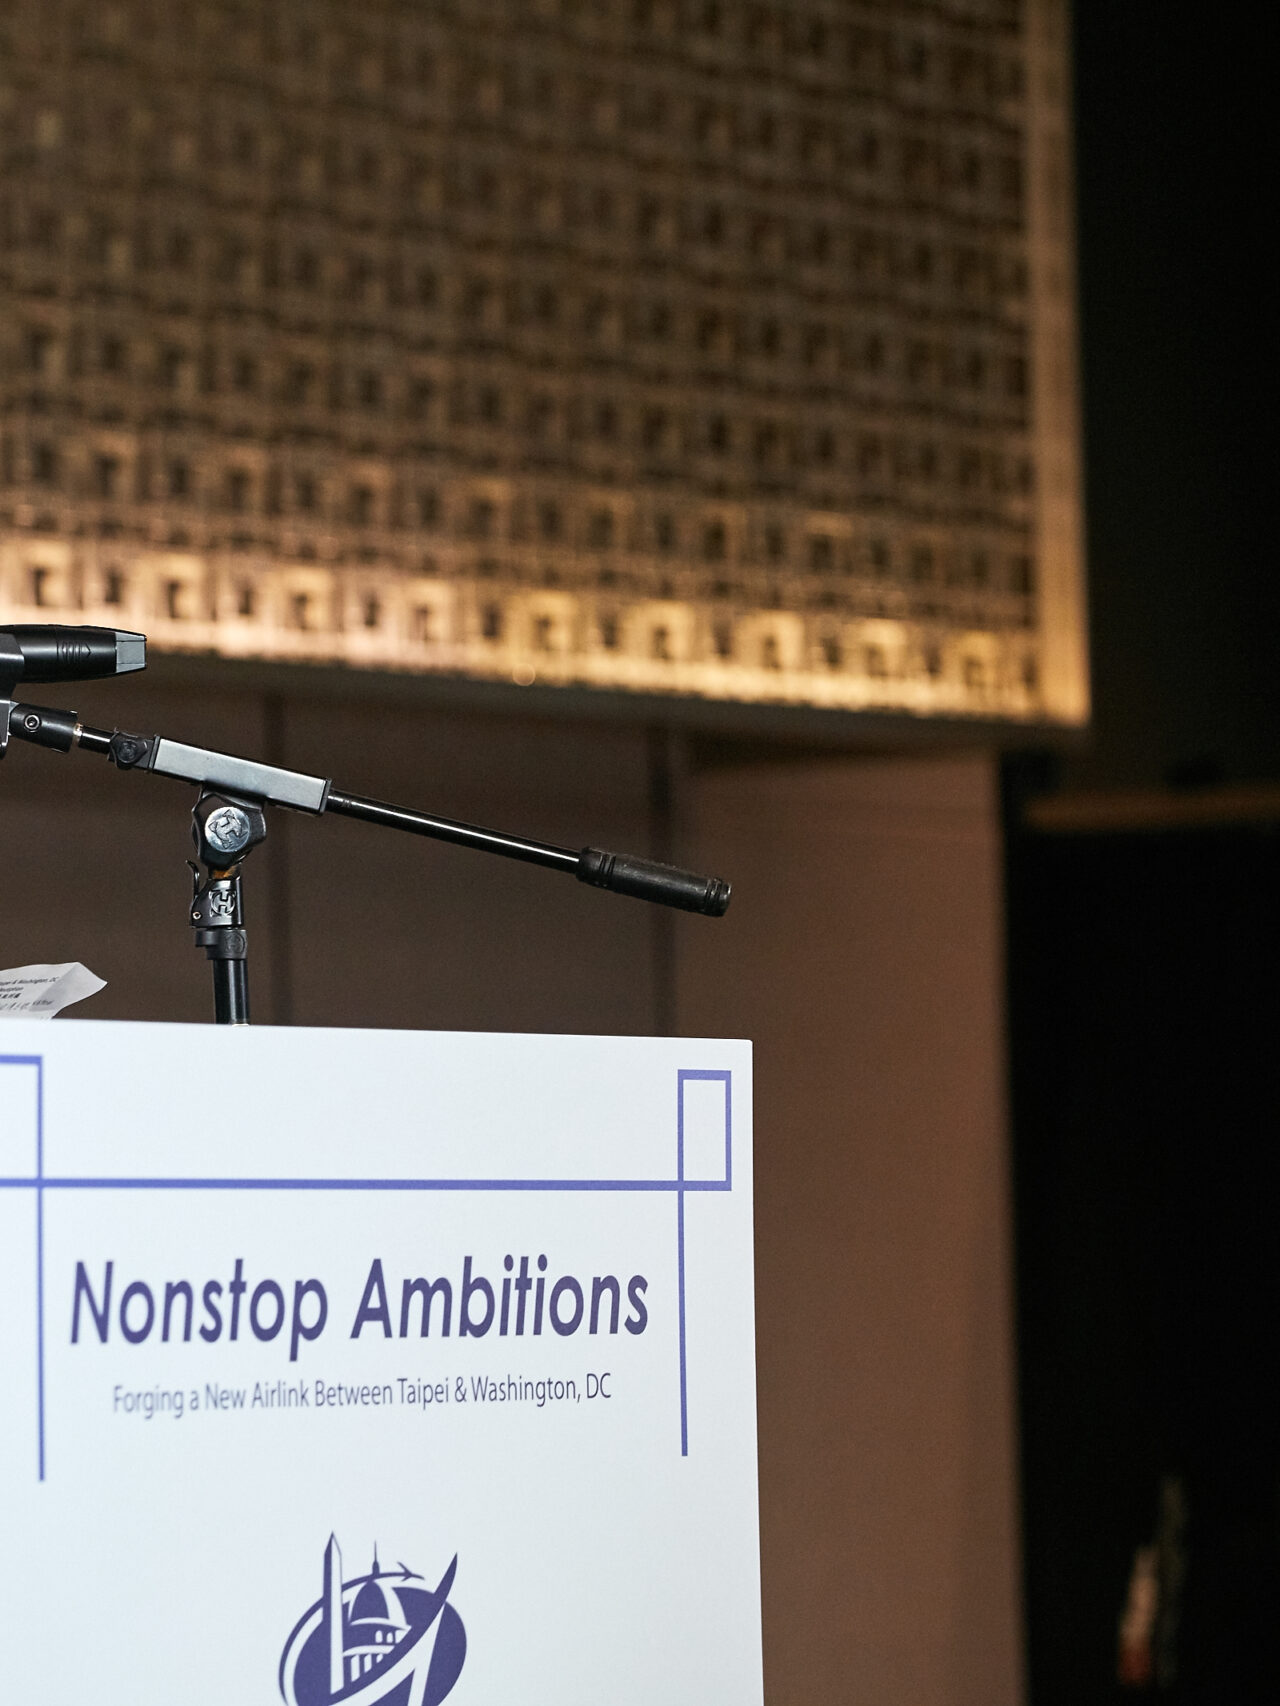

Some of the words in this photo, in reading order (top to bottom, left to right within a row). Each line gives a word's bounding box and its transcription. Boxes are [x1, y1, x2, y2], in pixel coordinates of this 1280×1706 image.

[70, 1258, 328, 1362] Nonstop
[350, 1254, 648, 1339] Ambitions
[114, 1385, 184, 1420] Forging
[190, 1389, 200, 1412] a
[205, 1383, 246, 1411] New
[252, 1379, 310, 1409] Airlink
[315, 1380, 393, 1408] Between
[396, 1377, 449, 1411] Taipei
[454, 1376, 467, 1404] &
[470, 1373, 581, 1408] Washington,
[586, 1372, 612, 1400] DC
